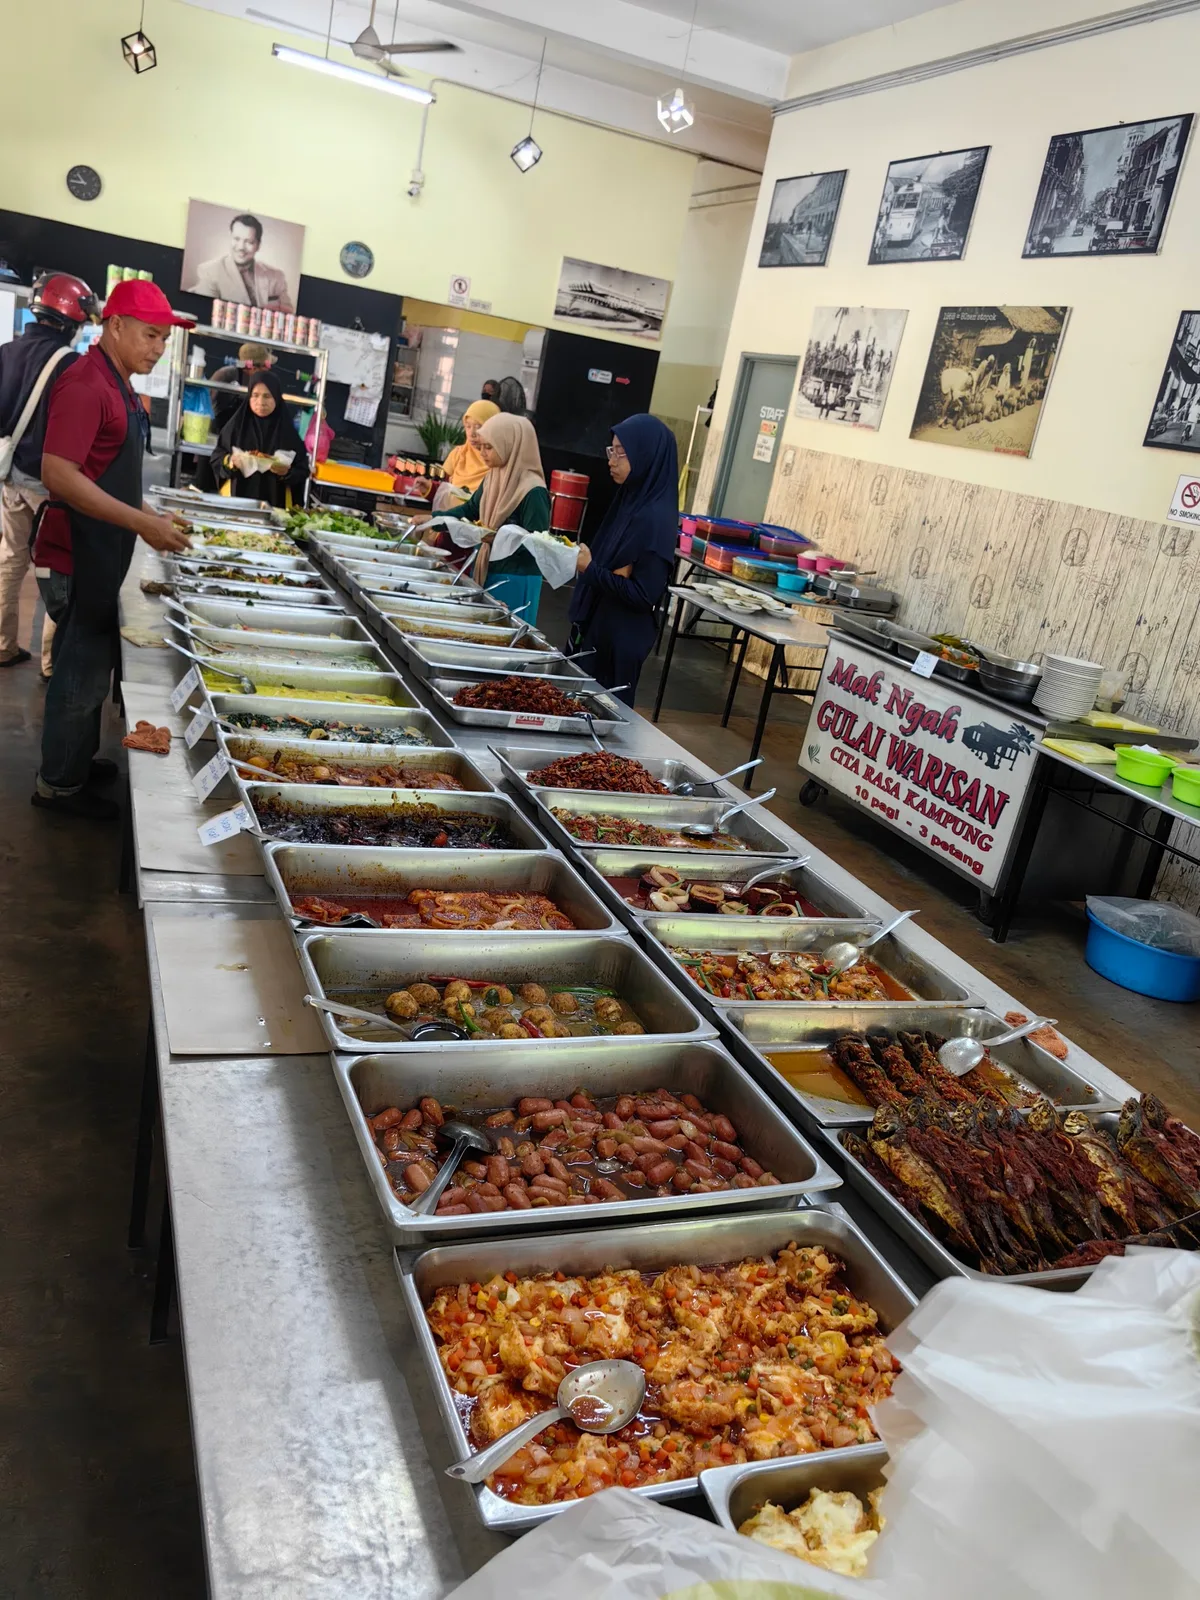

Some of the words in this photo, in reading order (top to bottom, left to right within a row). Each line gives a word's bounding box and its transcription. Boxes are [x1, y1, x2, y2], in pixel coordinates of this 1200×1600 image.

[760, 406, 785, 421] STAFF
[827, 657, 885, 705] Mak
[883, 683, 962, 743] Ngah
[817, 700, 886, 762] GULAI
[885, 733, 1010, 829] WARISAN
[830, 746, 859, 775] CITA
[862, 764, 900, 800] RASA
[902, 789, 994, 852] KAMPUNG
[855, 785, 869, 801] 10
[870, 797, 899, 820] pagi
[919, 825, 929, 838] 3
[930, 834, 984, 875] petang
